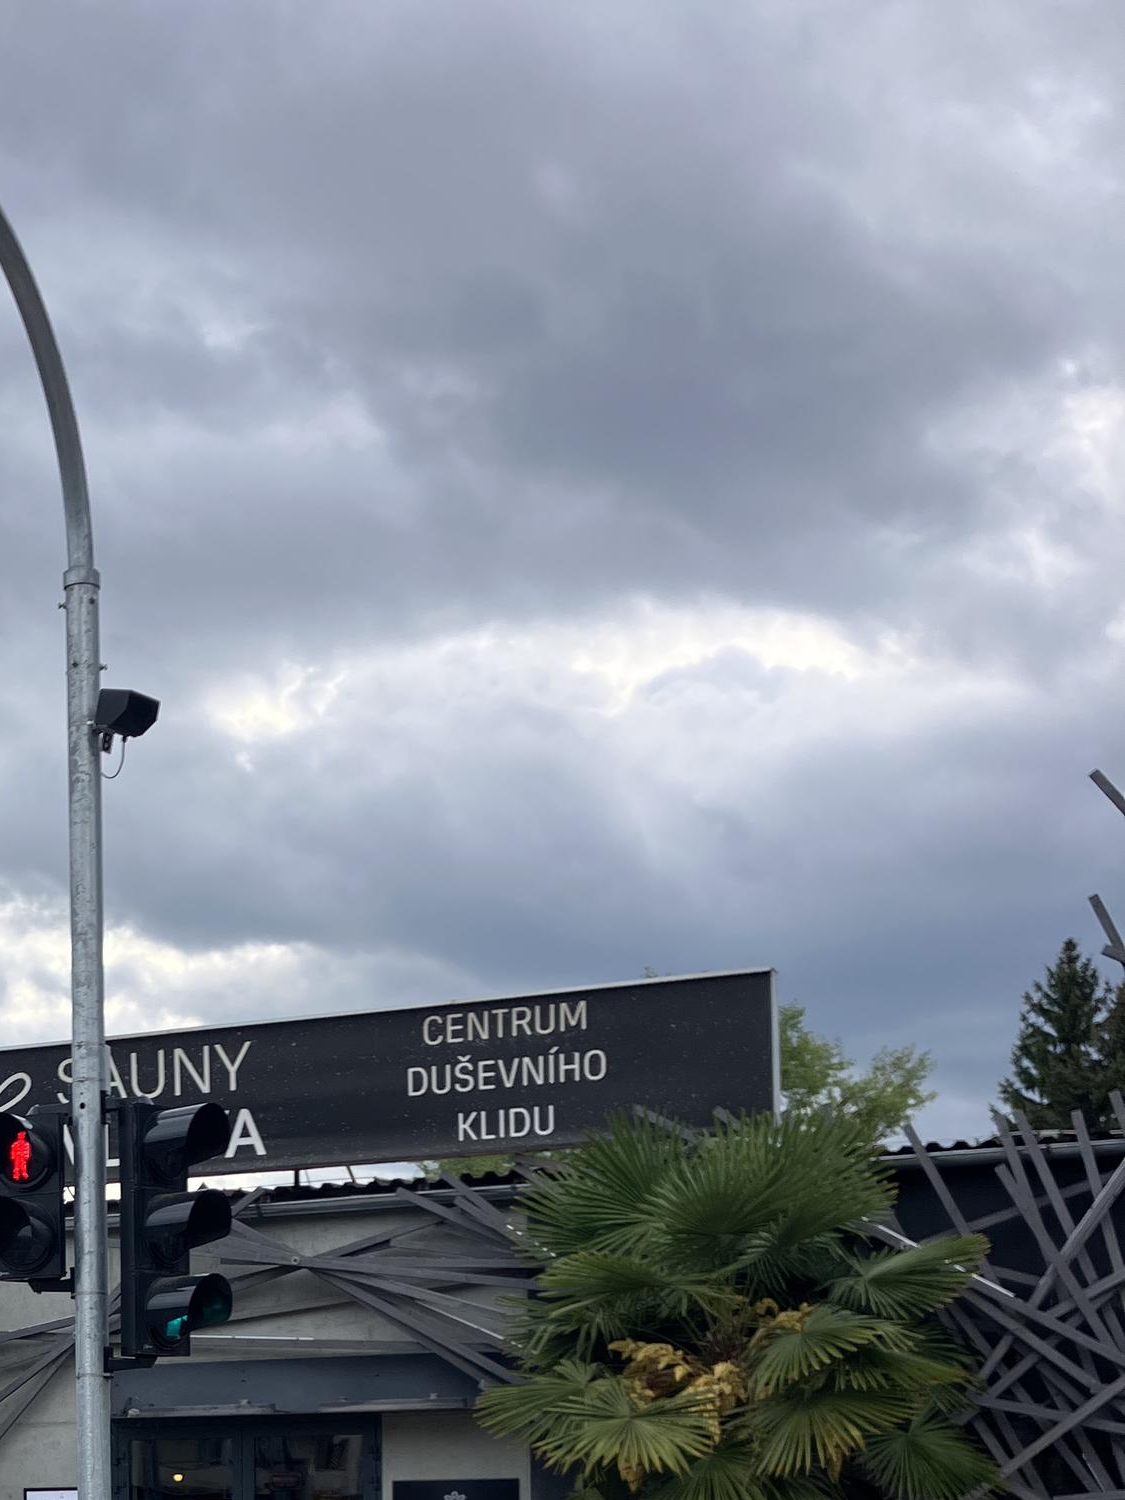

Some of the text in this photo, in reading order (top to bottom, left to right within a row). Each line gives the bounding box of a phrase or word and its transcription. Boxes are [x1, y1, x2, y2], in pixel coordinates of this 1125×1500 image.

[423, 1000, 588, 1046] CENTRUM
[406, 1046, 607, 1097] DUŠEVNÍHO
[457, 1105, 555, 1141] KLIDU
